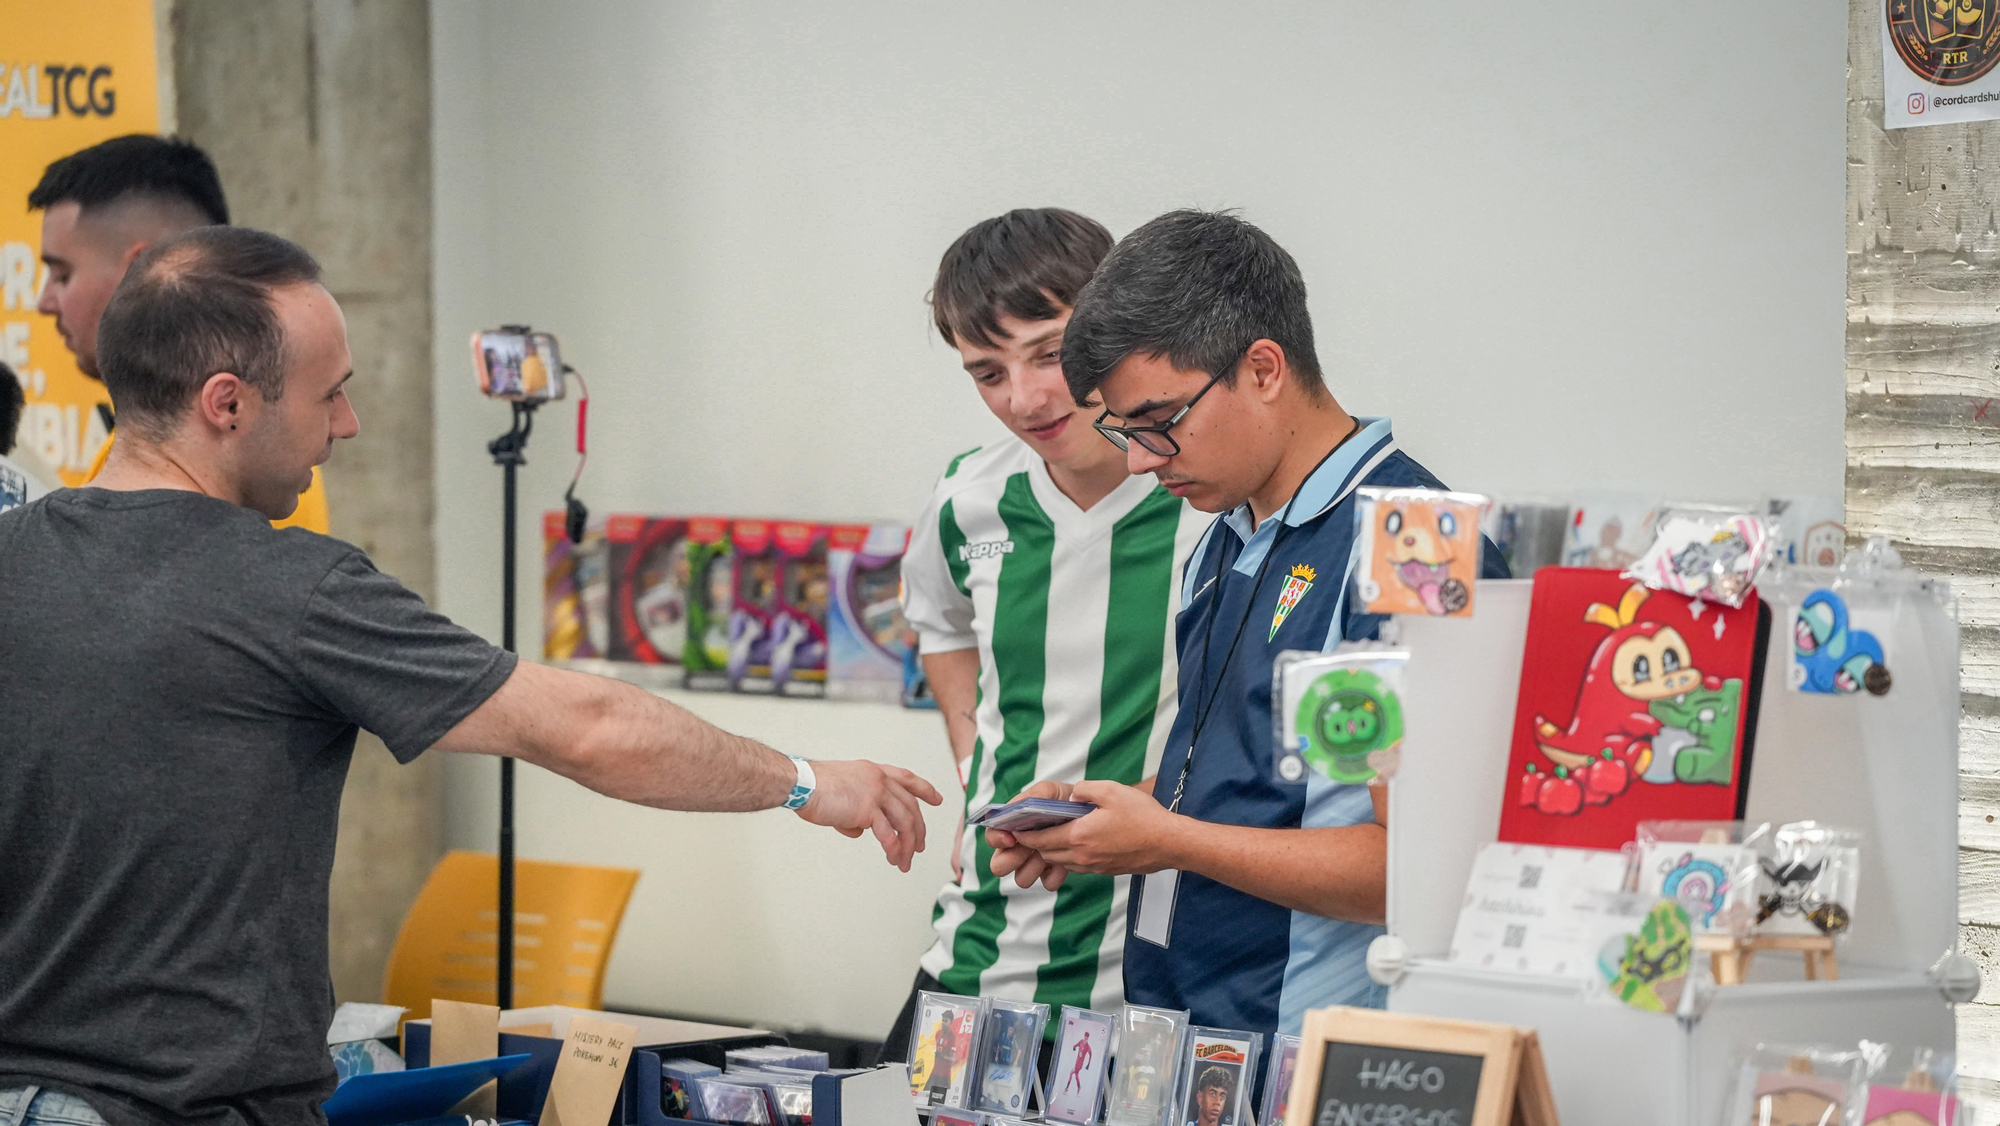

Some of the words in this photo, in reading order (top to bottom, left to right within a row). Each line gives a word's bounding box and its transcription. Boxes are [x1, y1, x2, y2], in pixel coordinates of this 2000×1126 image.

[1942, 51, 1969, 65] RTR
[958, 541, 1015, 561] Kappa
[962, 1024, 972, 1033] 17
[1195, 1048, 1203, 1058] FC
[1203, 1044, 1237, 1058] BARCELONA
[1357, 1057, 1445, 1093] HAGO
[1137, 1084, 1149, 1100] 10
